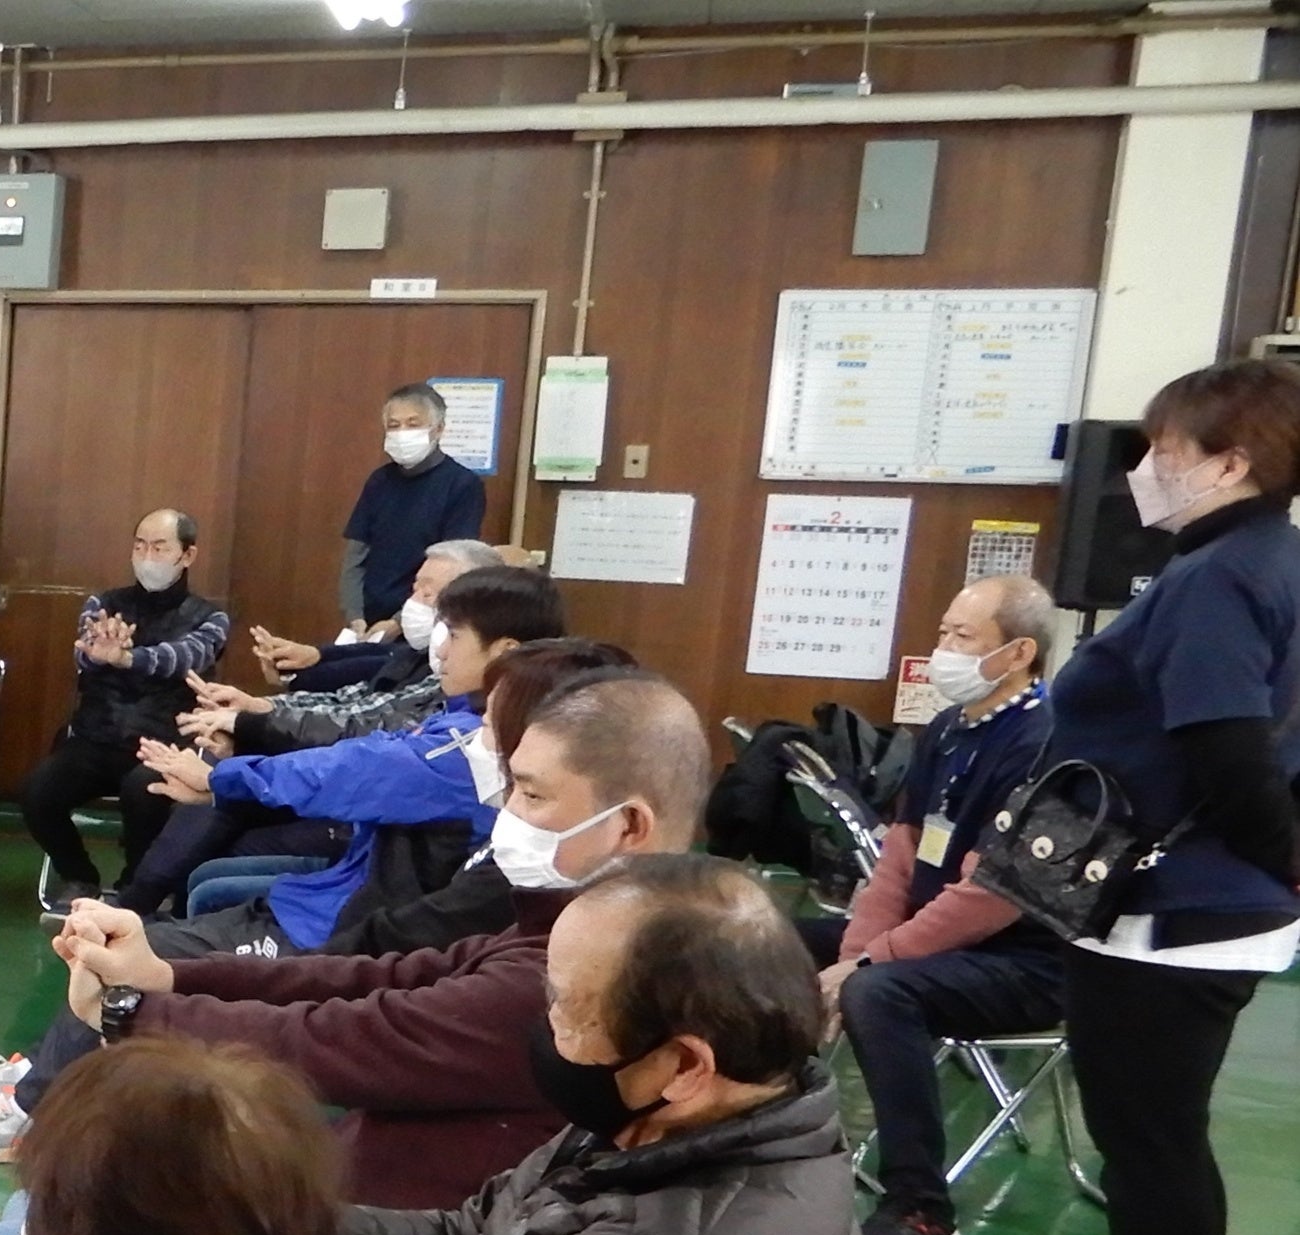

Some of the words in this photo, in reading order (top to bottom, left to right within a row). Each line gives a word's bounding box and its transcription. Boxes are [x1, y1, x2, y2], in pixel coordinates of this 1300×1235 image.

[830, 511, 842, 524] 2
[877, 563, 888, 572] 10
[765, 587, 775, 596] 11
[783, 587, 794, 596] 12
[801, 588, 812, 597] 13
[819, 589, 830, 597] 14
[837, 590, 848, 598] 15
[855, 590, 866, 599] 16
[873, 591, 885, 600] 17
[762, 614, 773, 622] 18
[780, 614, 791, 623] 19
[797, 615, 809, 624] 20
[815, 616, 826, 624] 21
[833, 617, 845, 625] 22
[850, 617, 863, 626] 23
[869, 618, 881, 627] 24
[758, 641, 769, 649] 25
[776, 641, 788, 650] 26
[794, 642, 806, 651] 27
[811, 643, 823, 651] 28
[829, 644, 842, 652] 29
